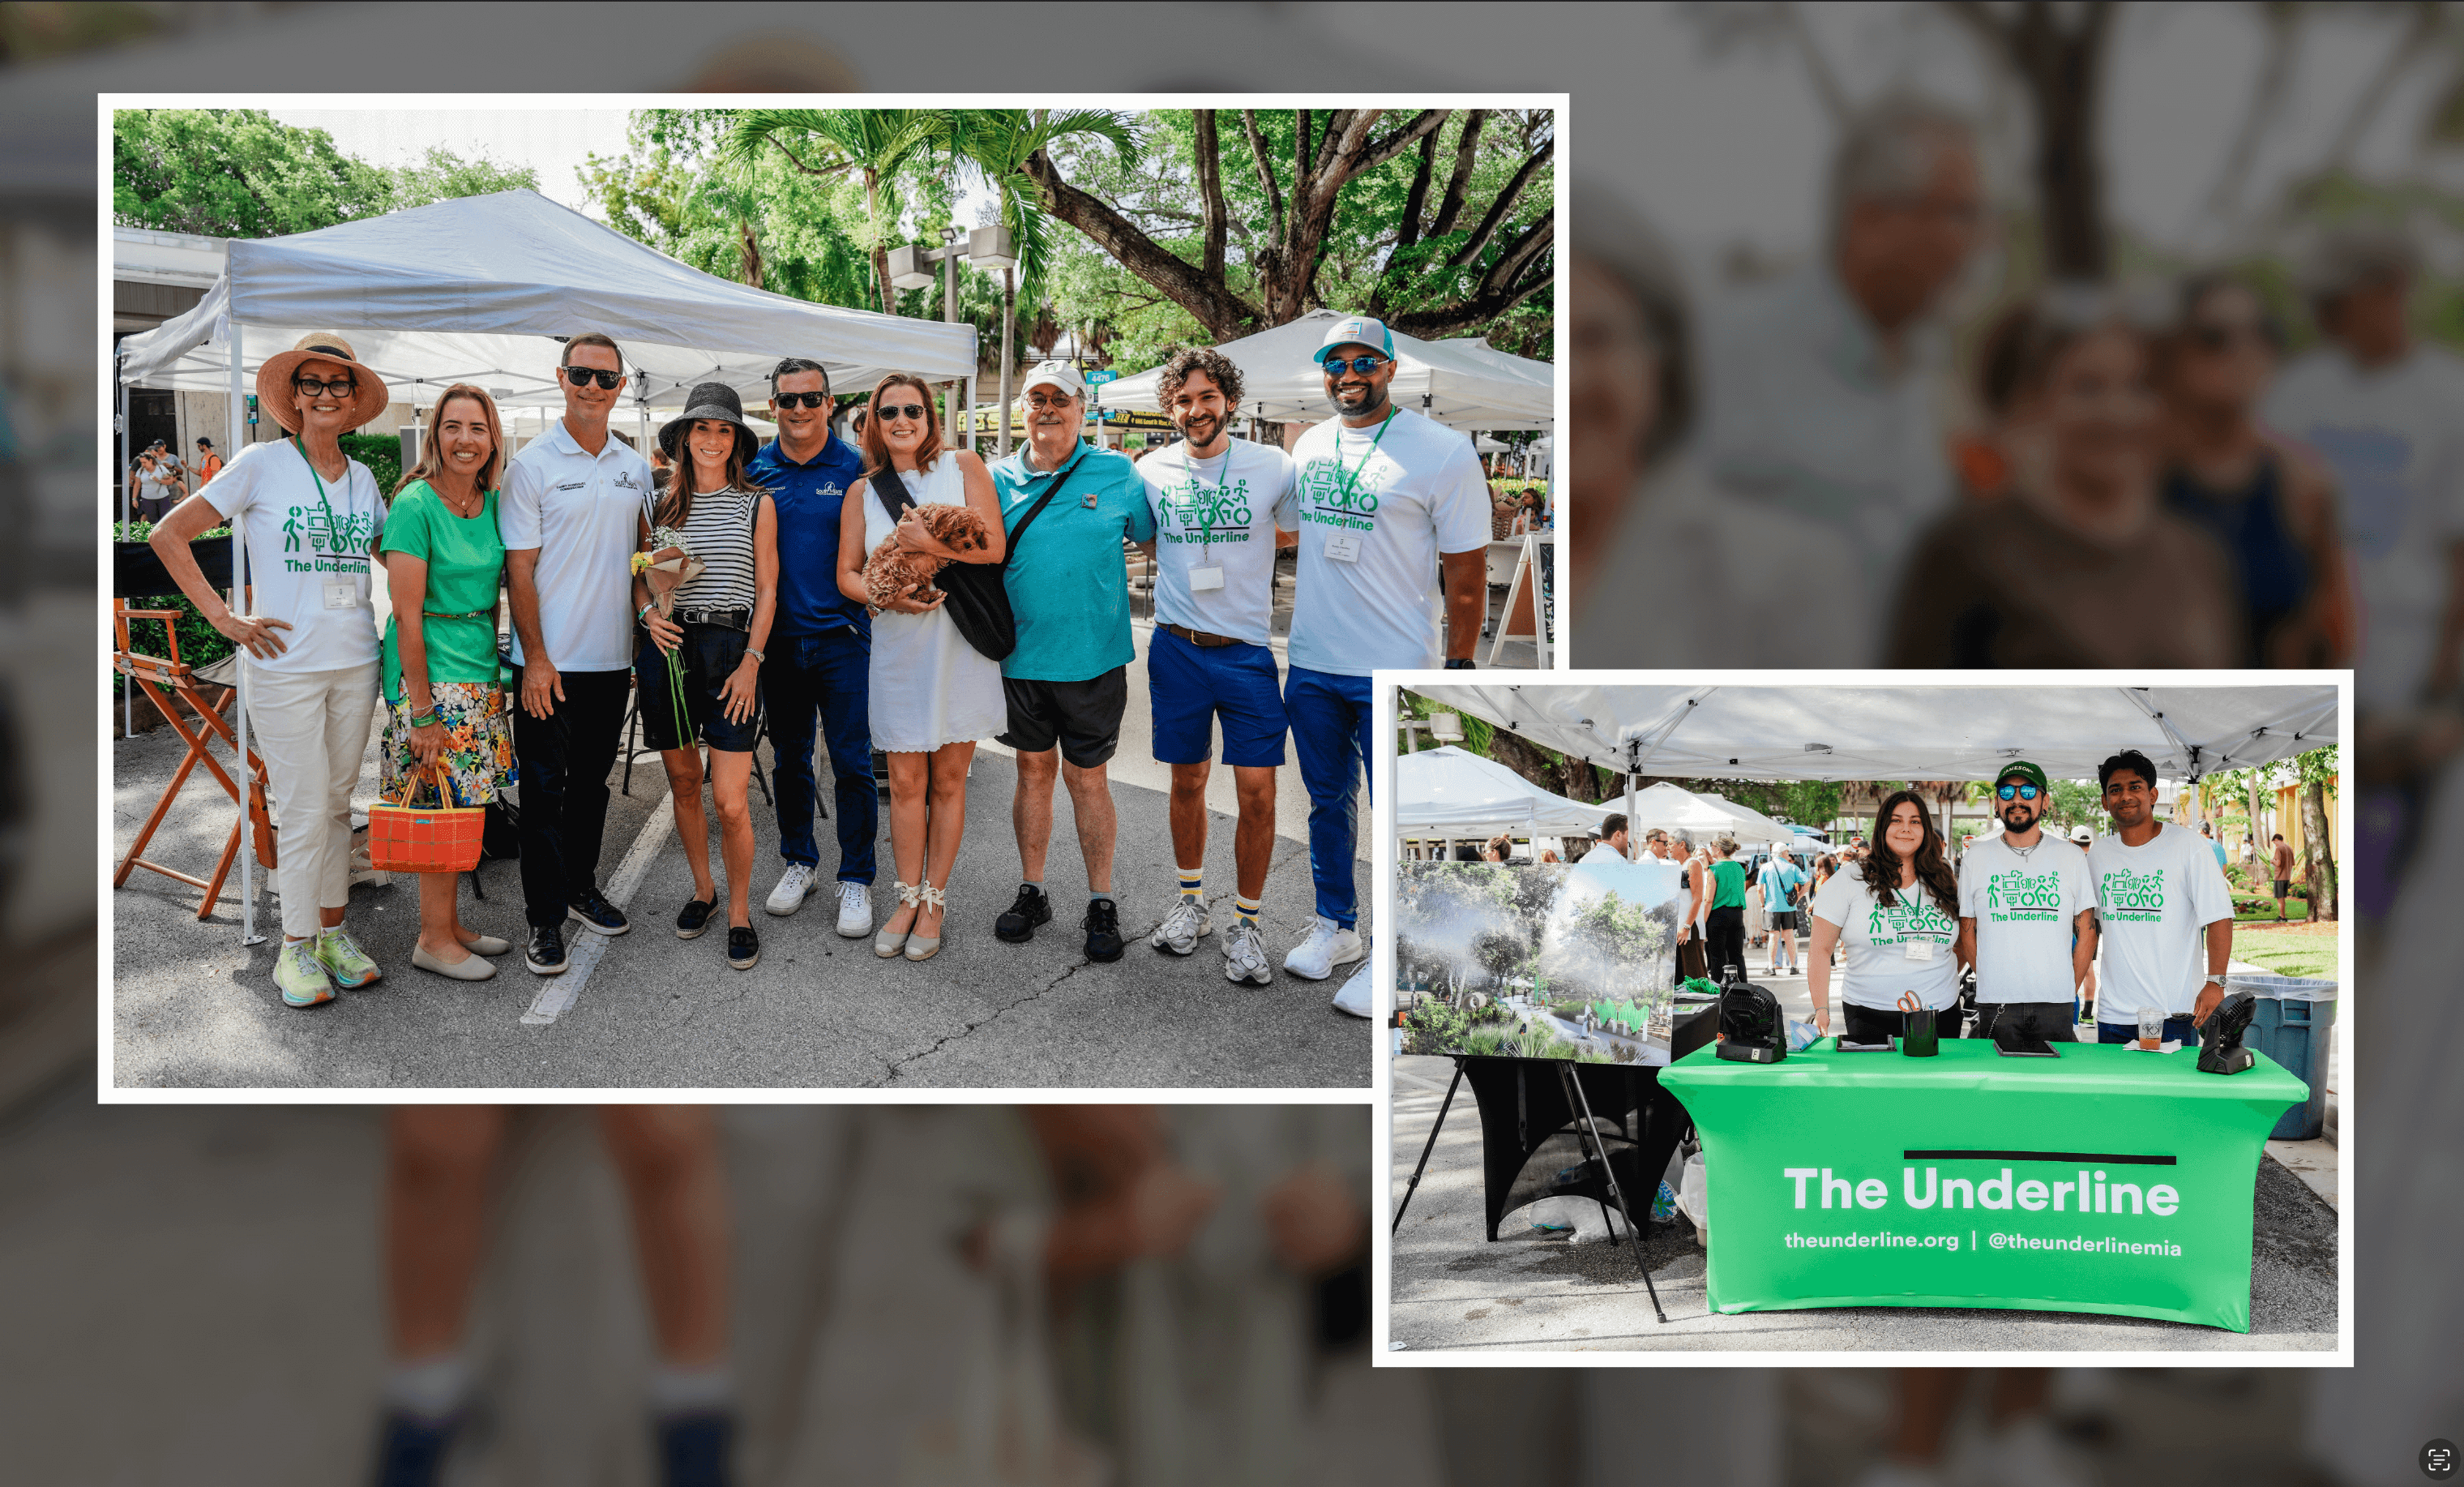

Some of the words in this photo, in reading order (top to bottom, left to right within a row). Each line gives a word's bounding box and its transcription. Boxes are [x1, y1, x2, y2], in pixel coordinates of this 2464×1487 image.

[1091, 374, 1110, 383] 4476
[1298, 509, 1312, 522] The
[1314, 511, 1374, 532] Underline
[1164, 532, 1183, 544] The
[1185, 531, 1250, 544] Underline
[284, 559, 312, 572] The
[2002, 765, 2031, 775] JAMESON
[1991, 912, 2008, 923] The
[2010, 911, 2059, 922] Underline
[2102, 911, 2115, 921] The
[2116, 911, 2162, 923] Underline
[1870, 937, 1893, 946] The
[1784, 1168, 1889, 1210] The
[1903, 1167, 2180, 1216] Underline
[1784, 1231, 1960, 1252] theunderline.org
[1988, 1232, 2182, 1257] @theunderlinemia
